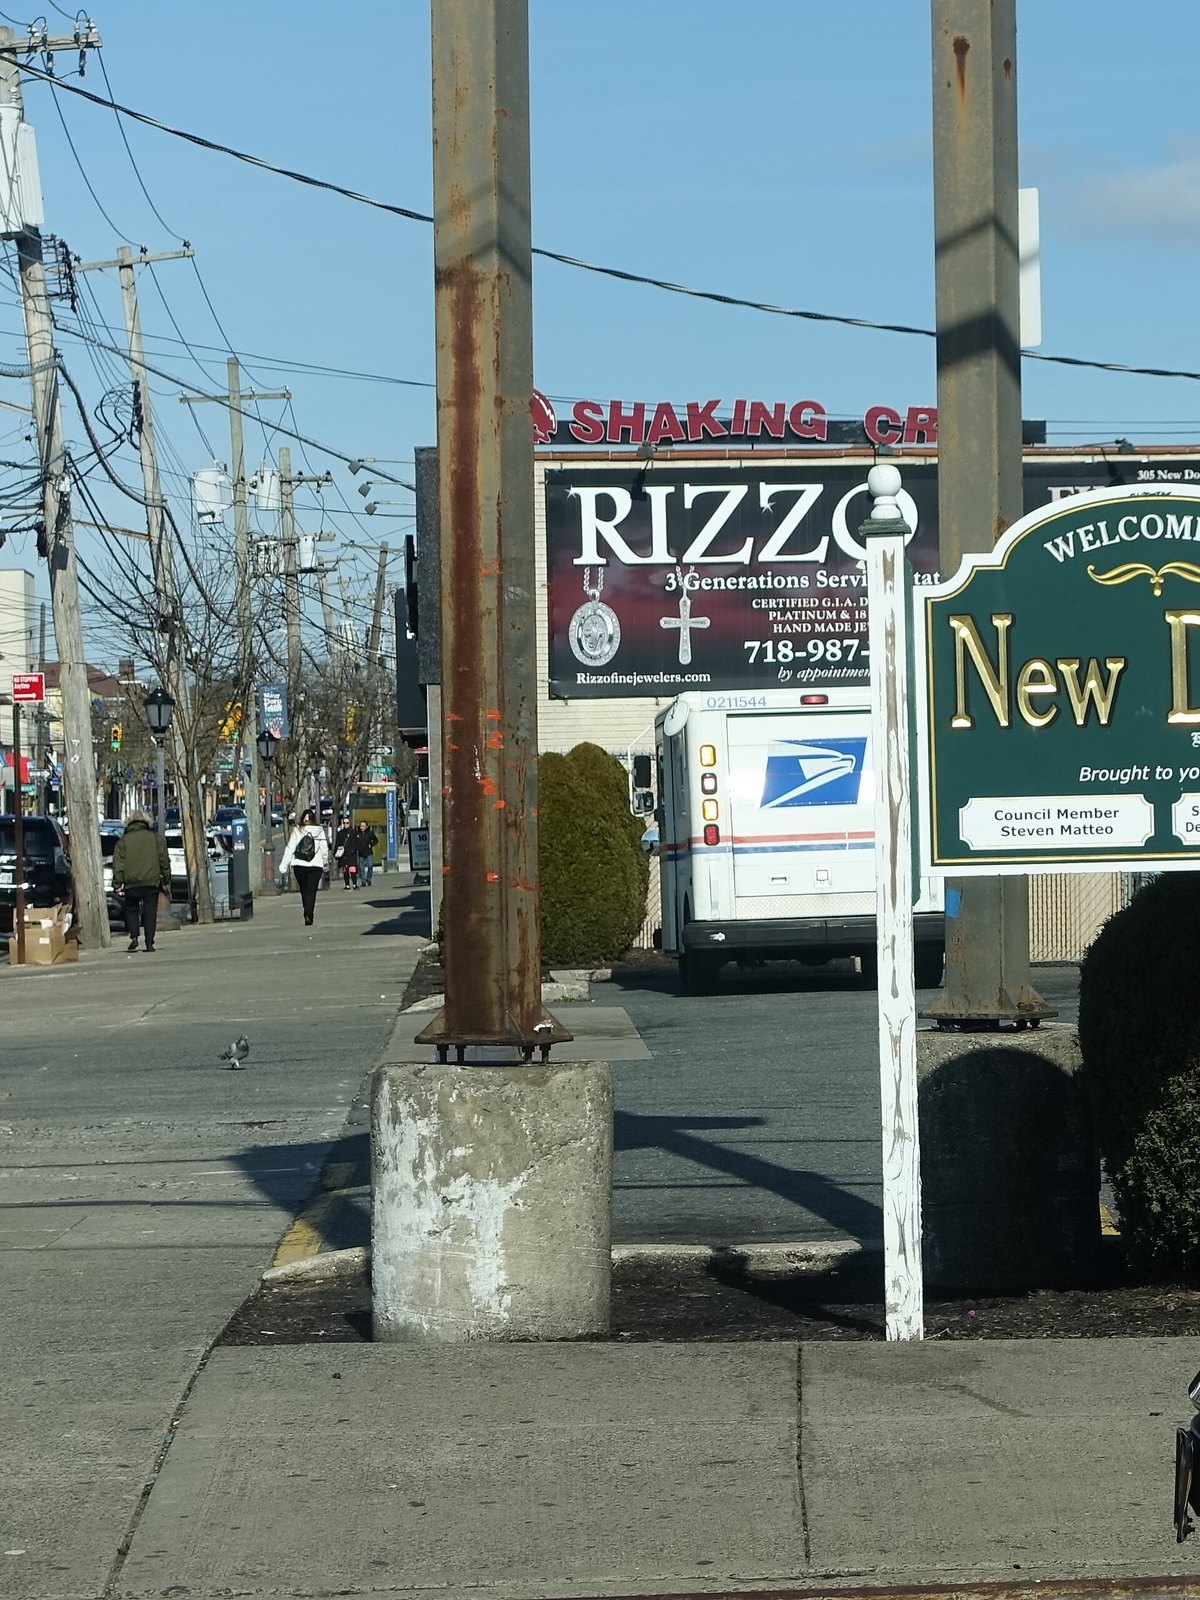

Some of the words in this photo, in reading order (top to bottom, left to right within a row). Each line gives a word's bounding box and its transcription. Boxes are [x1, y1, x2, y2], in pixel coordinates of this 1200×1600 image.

[569, 399, 827, 444] SHAKING
[1137, 470, 1155, 481] 305
[1157, 470, 1182, 480] New
[571, 482, 918, 566] RIZZO
[665, 573, 677, 591] 3
[684, 572, 809, 591] Generations
[752, 598, 819, 609] CERTIFIED
[822, 597, 857, 608] G.I.A.
[769, 610, 837, 621] PLATINUM
[840, 609, 850, 620] &
[773, 623, 812, 634] HAND
[814, 622, 851, 633] MADE
[744, 638, 869, 664] 718-987-
[778, 668, 793, 682] by
[949, 612, 1126, 728] New
[576, 671, 711, 686] Rizzofinejewelers.com
[706, 695, 768, 709] 0211544
[1079, 765, 1149, 784] Brought
[1155, 766, 1173, 780] to
[994, 808, 1050, 821] Council
[1057, 807, 1120, 820] Member
[1001, 825, 1054, 837] Steven
[1060, 824, 1114, 836] Matteo
